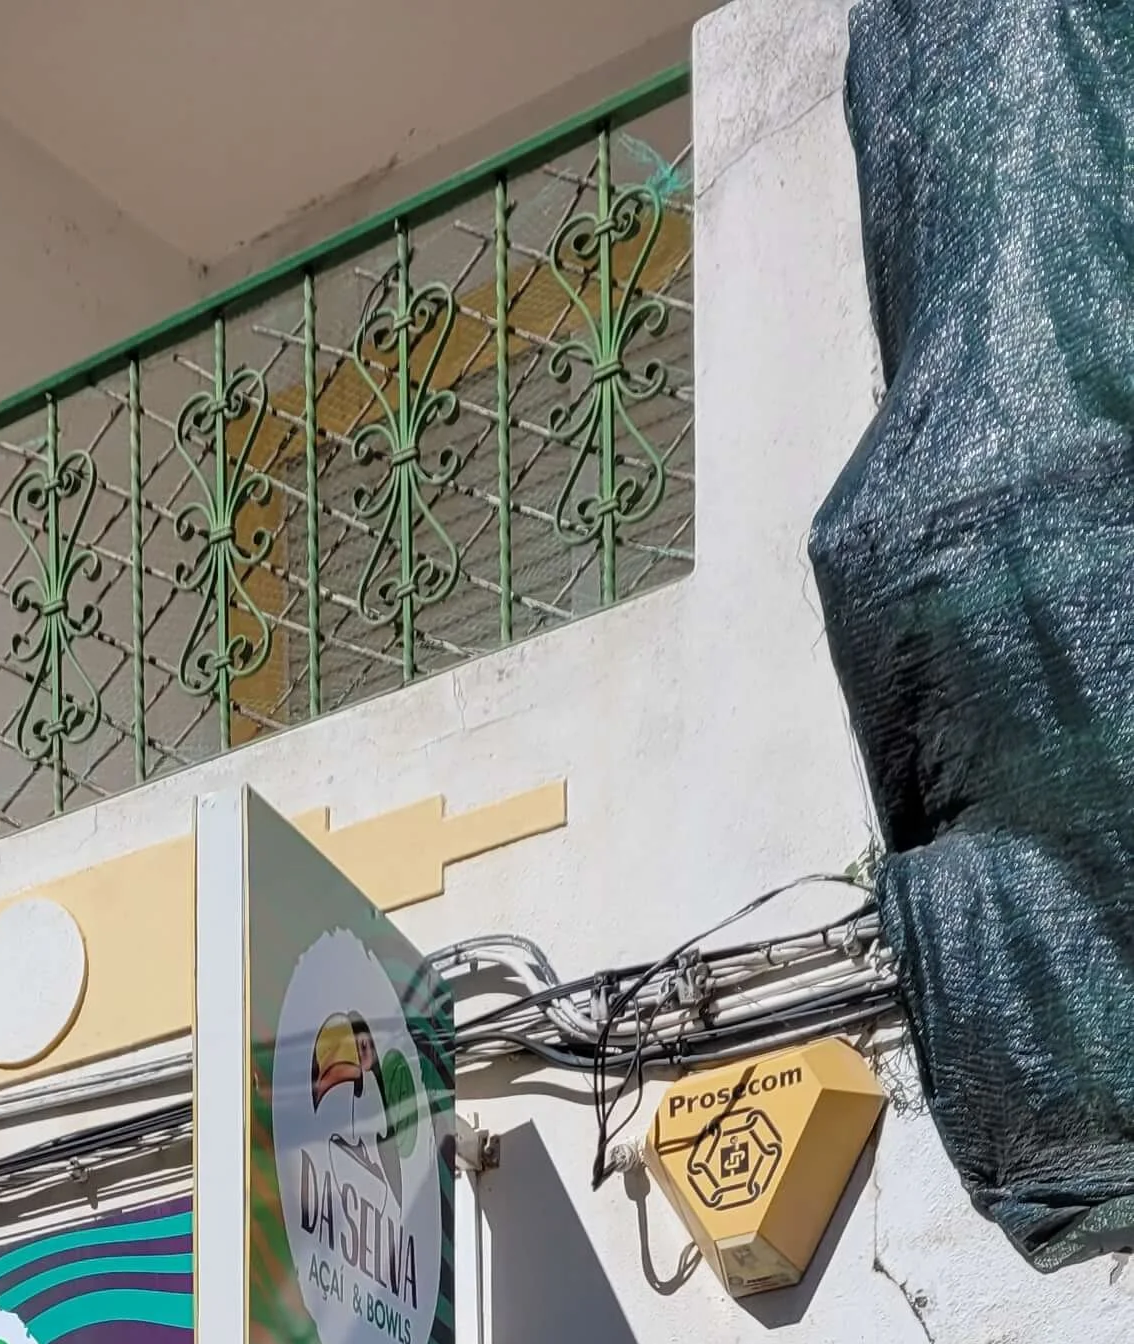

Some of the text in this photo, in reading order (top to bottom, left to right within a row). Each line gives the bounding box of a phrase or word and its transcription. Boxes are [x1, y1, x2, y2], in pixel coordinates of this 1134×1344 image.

[300, 1148, 417, 1310] DA SELVA
[308, 1253, 345, 1303] AÇAÍ
[352, 1283, 363, 1317] &
